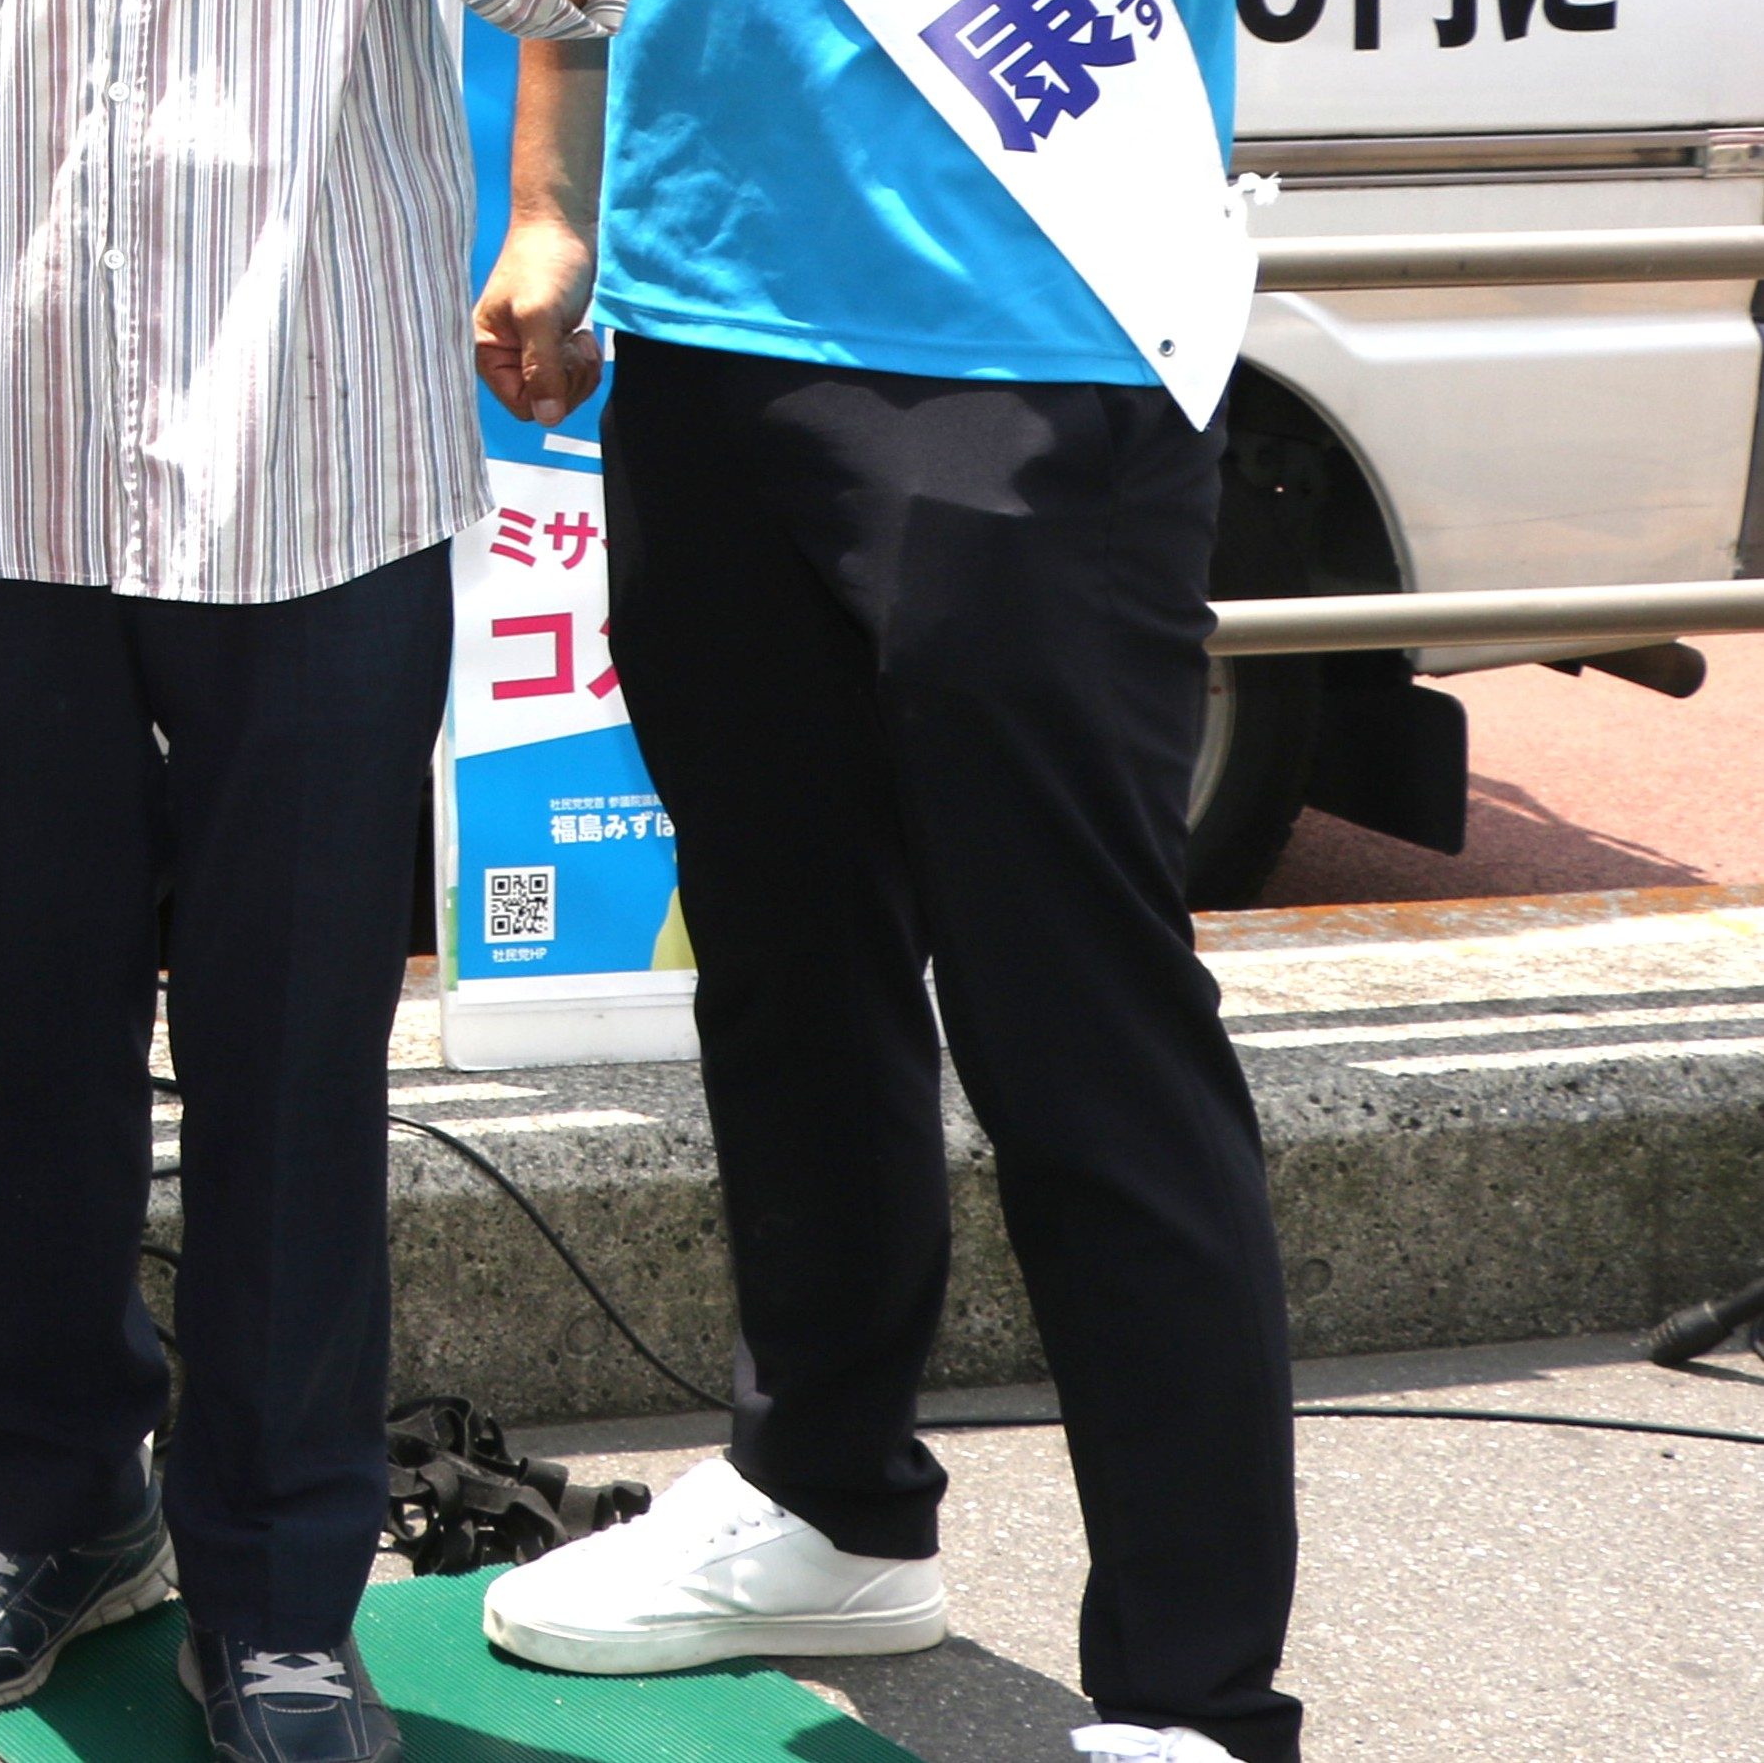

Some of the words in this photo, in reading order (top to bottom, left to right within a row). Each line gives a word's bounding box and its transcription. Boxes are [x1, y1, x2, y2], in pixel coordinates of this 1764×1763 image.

[489, 506, 609, 571] ミサ
[492, 946, 549, 963] 社民党HP
